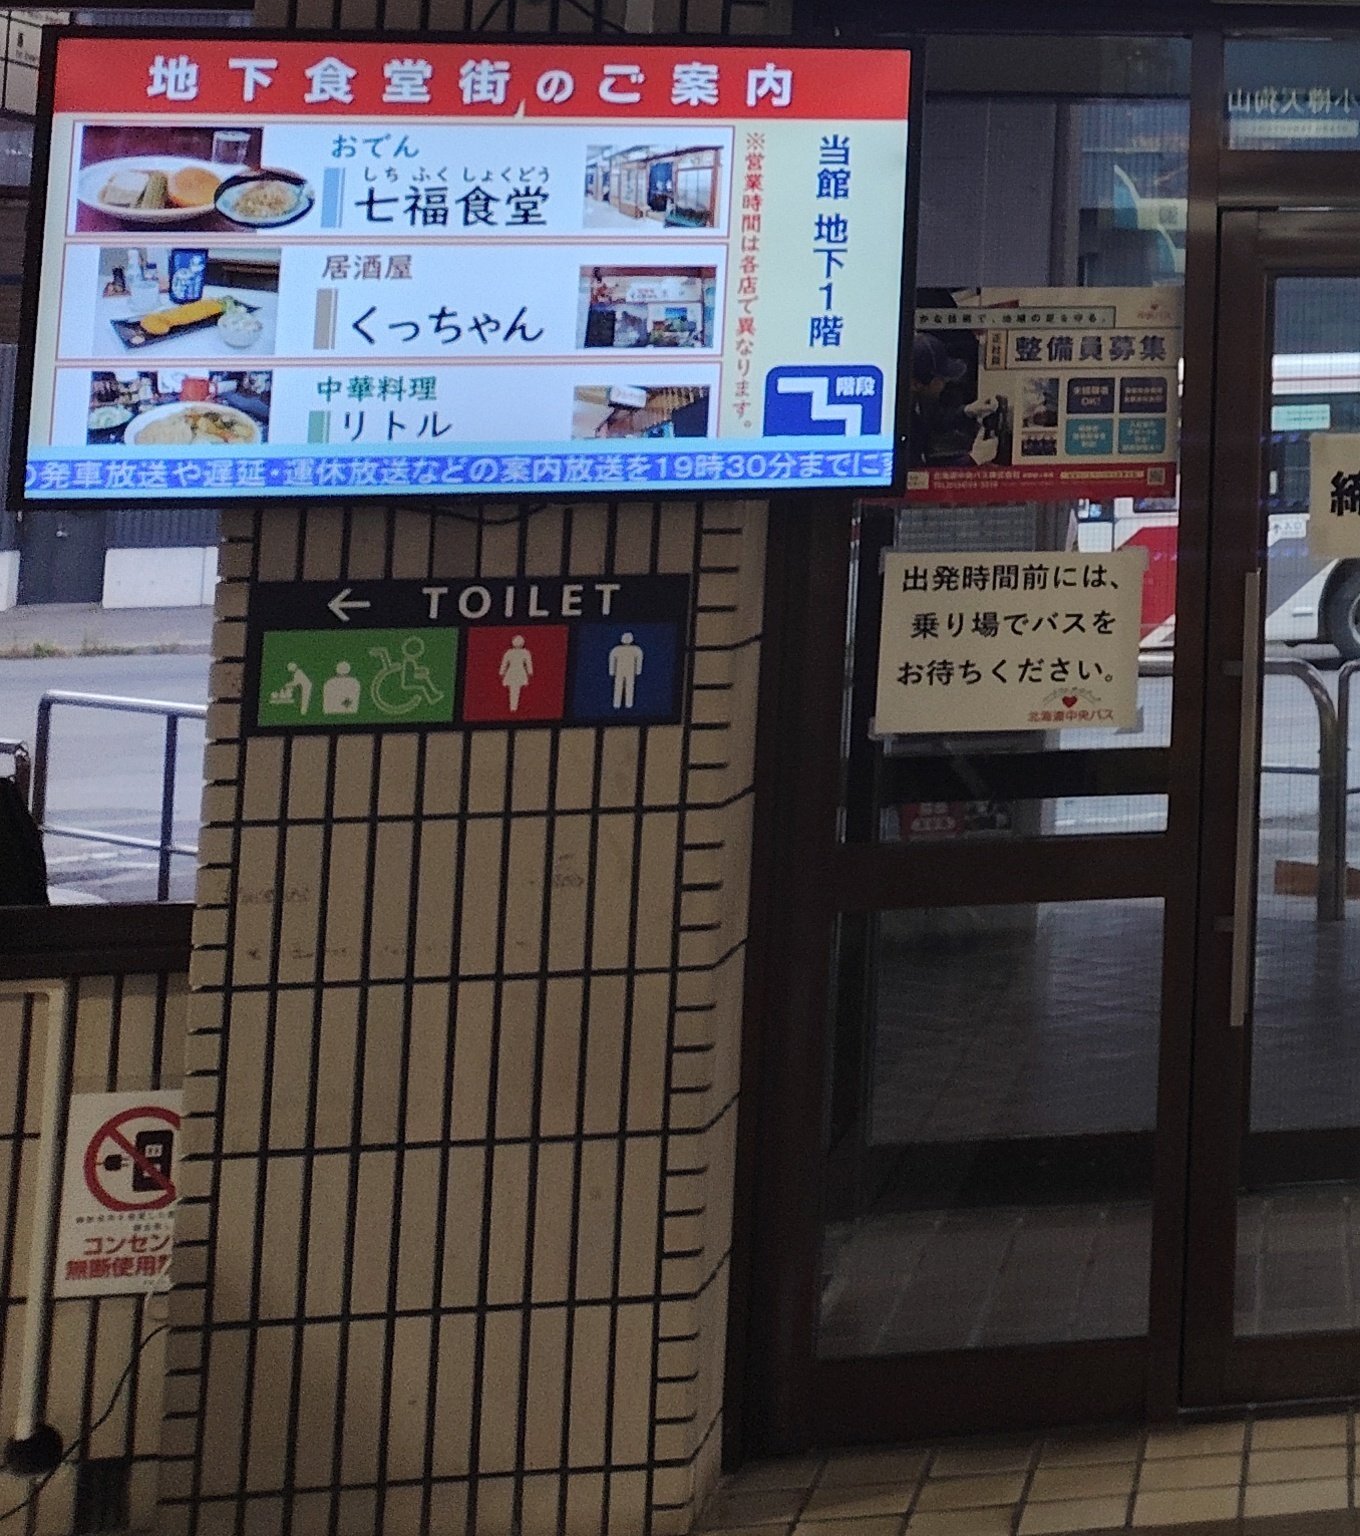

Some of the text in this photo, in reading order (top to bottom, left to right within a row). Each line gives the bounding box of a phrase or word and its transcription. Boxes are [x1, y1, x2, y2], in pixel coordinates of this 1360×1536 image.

[147, 54, 793, 107] 地下食堂街のご案内
[332, 134, 420, 159] おでん
[354, 186, 550, 227] 七福食堂
[322, 254, 413, 281] 居酒屋
[351, 305, 544, 344] くっちゃん
[1015, 336, 1166, 361] 整備員募集
[318, 375, 437, 401] 中華料理
[836, 375, 875, 397] 階段
[345, 410, 453, 441] リトル
[902, 564, 1121, 593] 出発時間前には、
[422, 583, 621, 619] TOILET
[912, 609, 1116, 639] 乗り場でバスを
[897, 658, 1115, 687] お待ちください。
